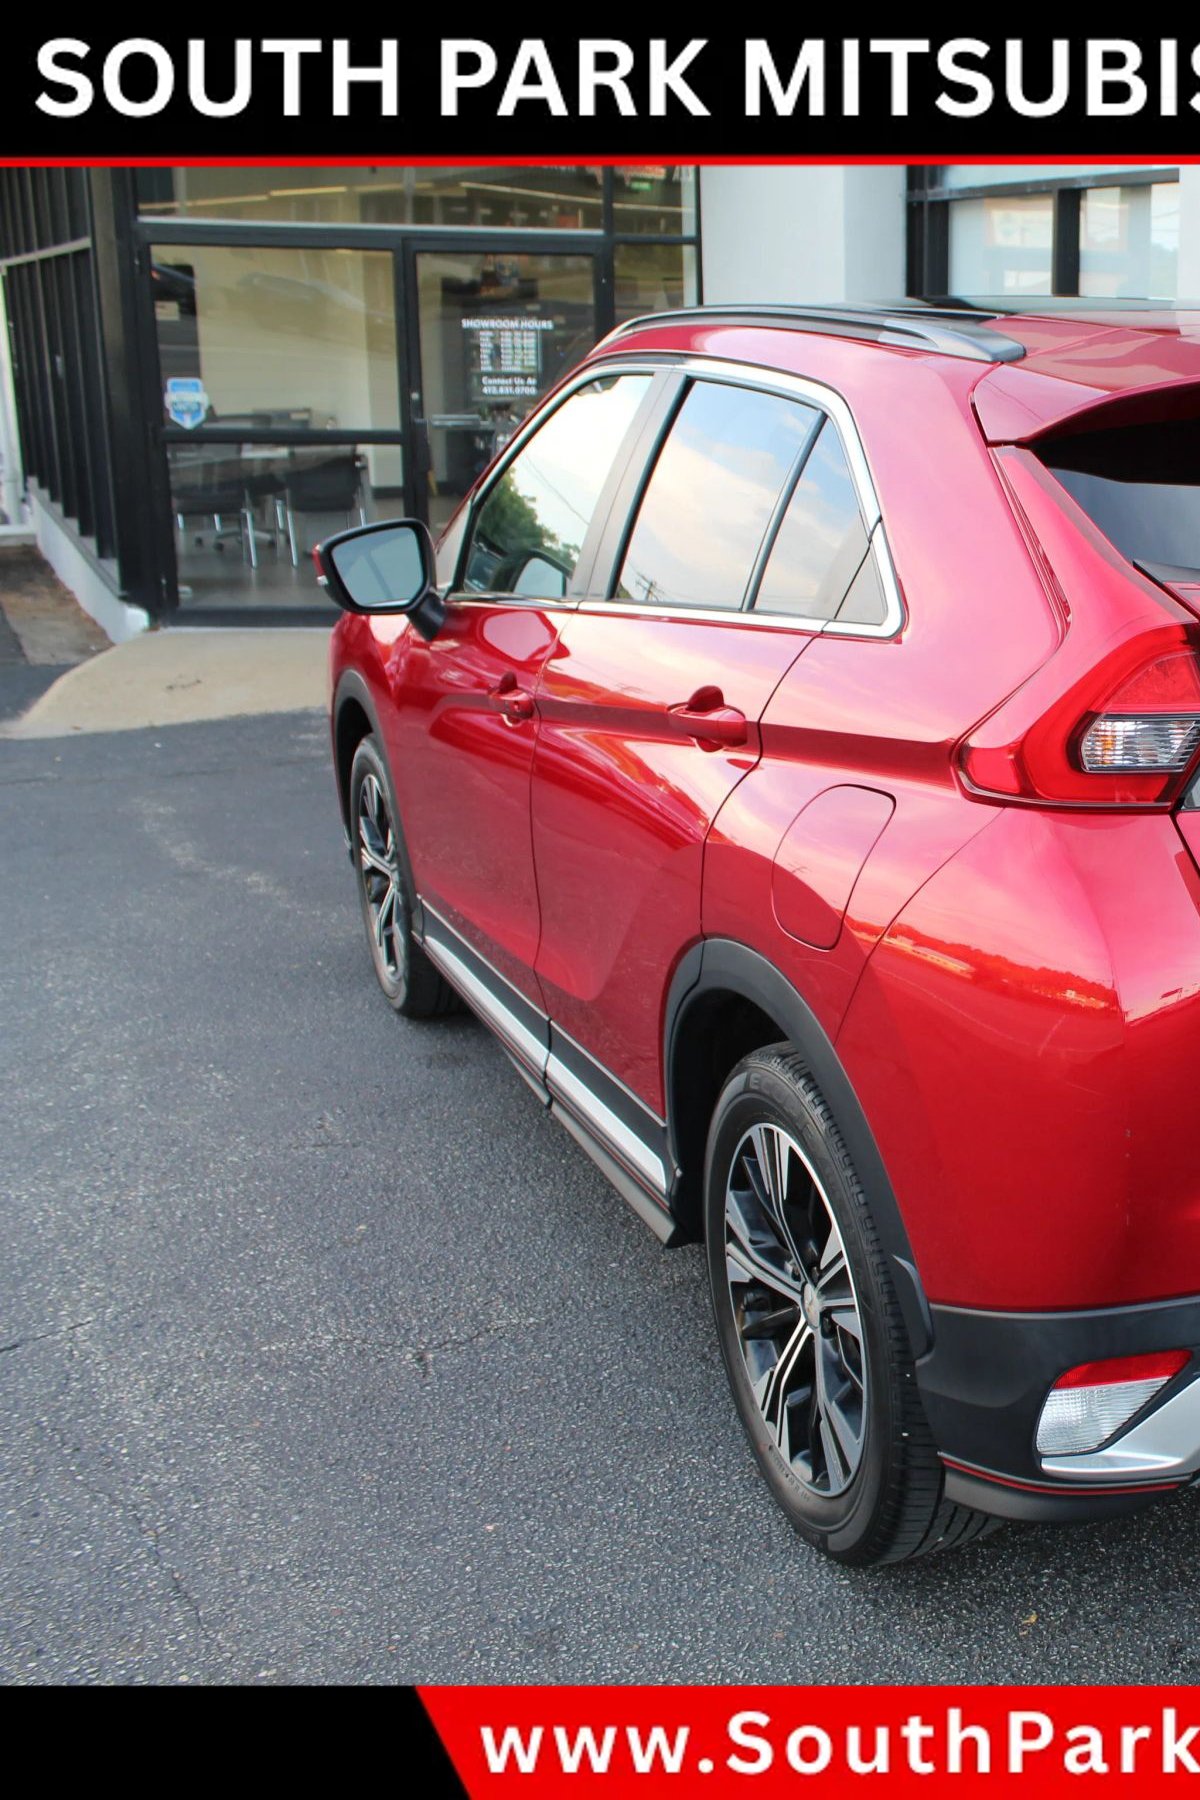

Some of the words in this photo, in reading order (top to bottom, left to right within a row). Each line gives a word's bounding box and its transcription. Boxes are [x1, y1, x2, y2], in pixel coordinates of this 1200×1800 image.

[462, 318, 519, 329] SHOWROOM
[520, 320, 554, 330] HOURS
[482, 376, 512, 386] Contact
[513, 377, 525, 386] Us
[526, 377, 537, 386] At
